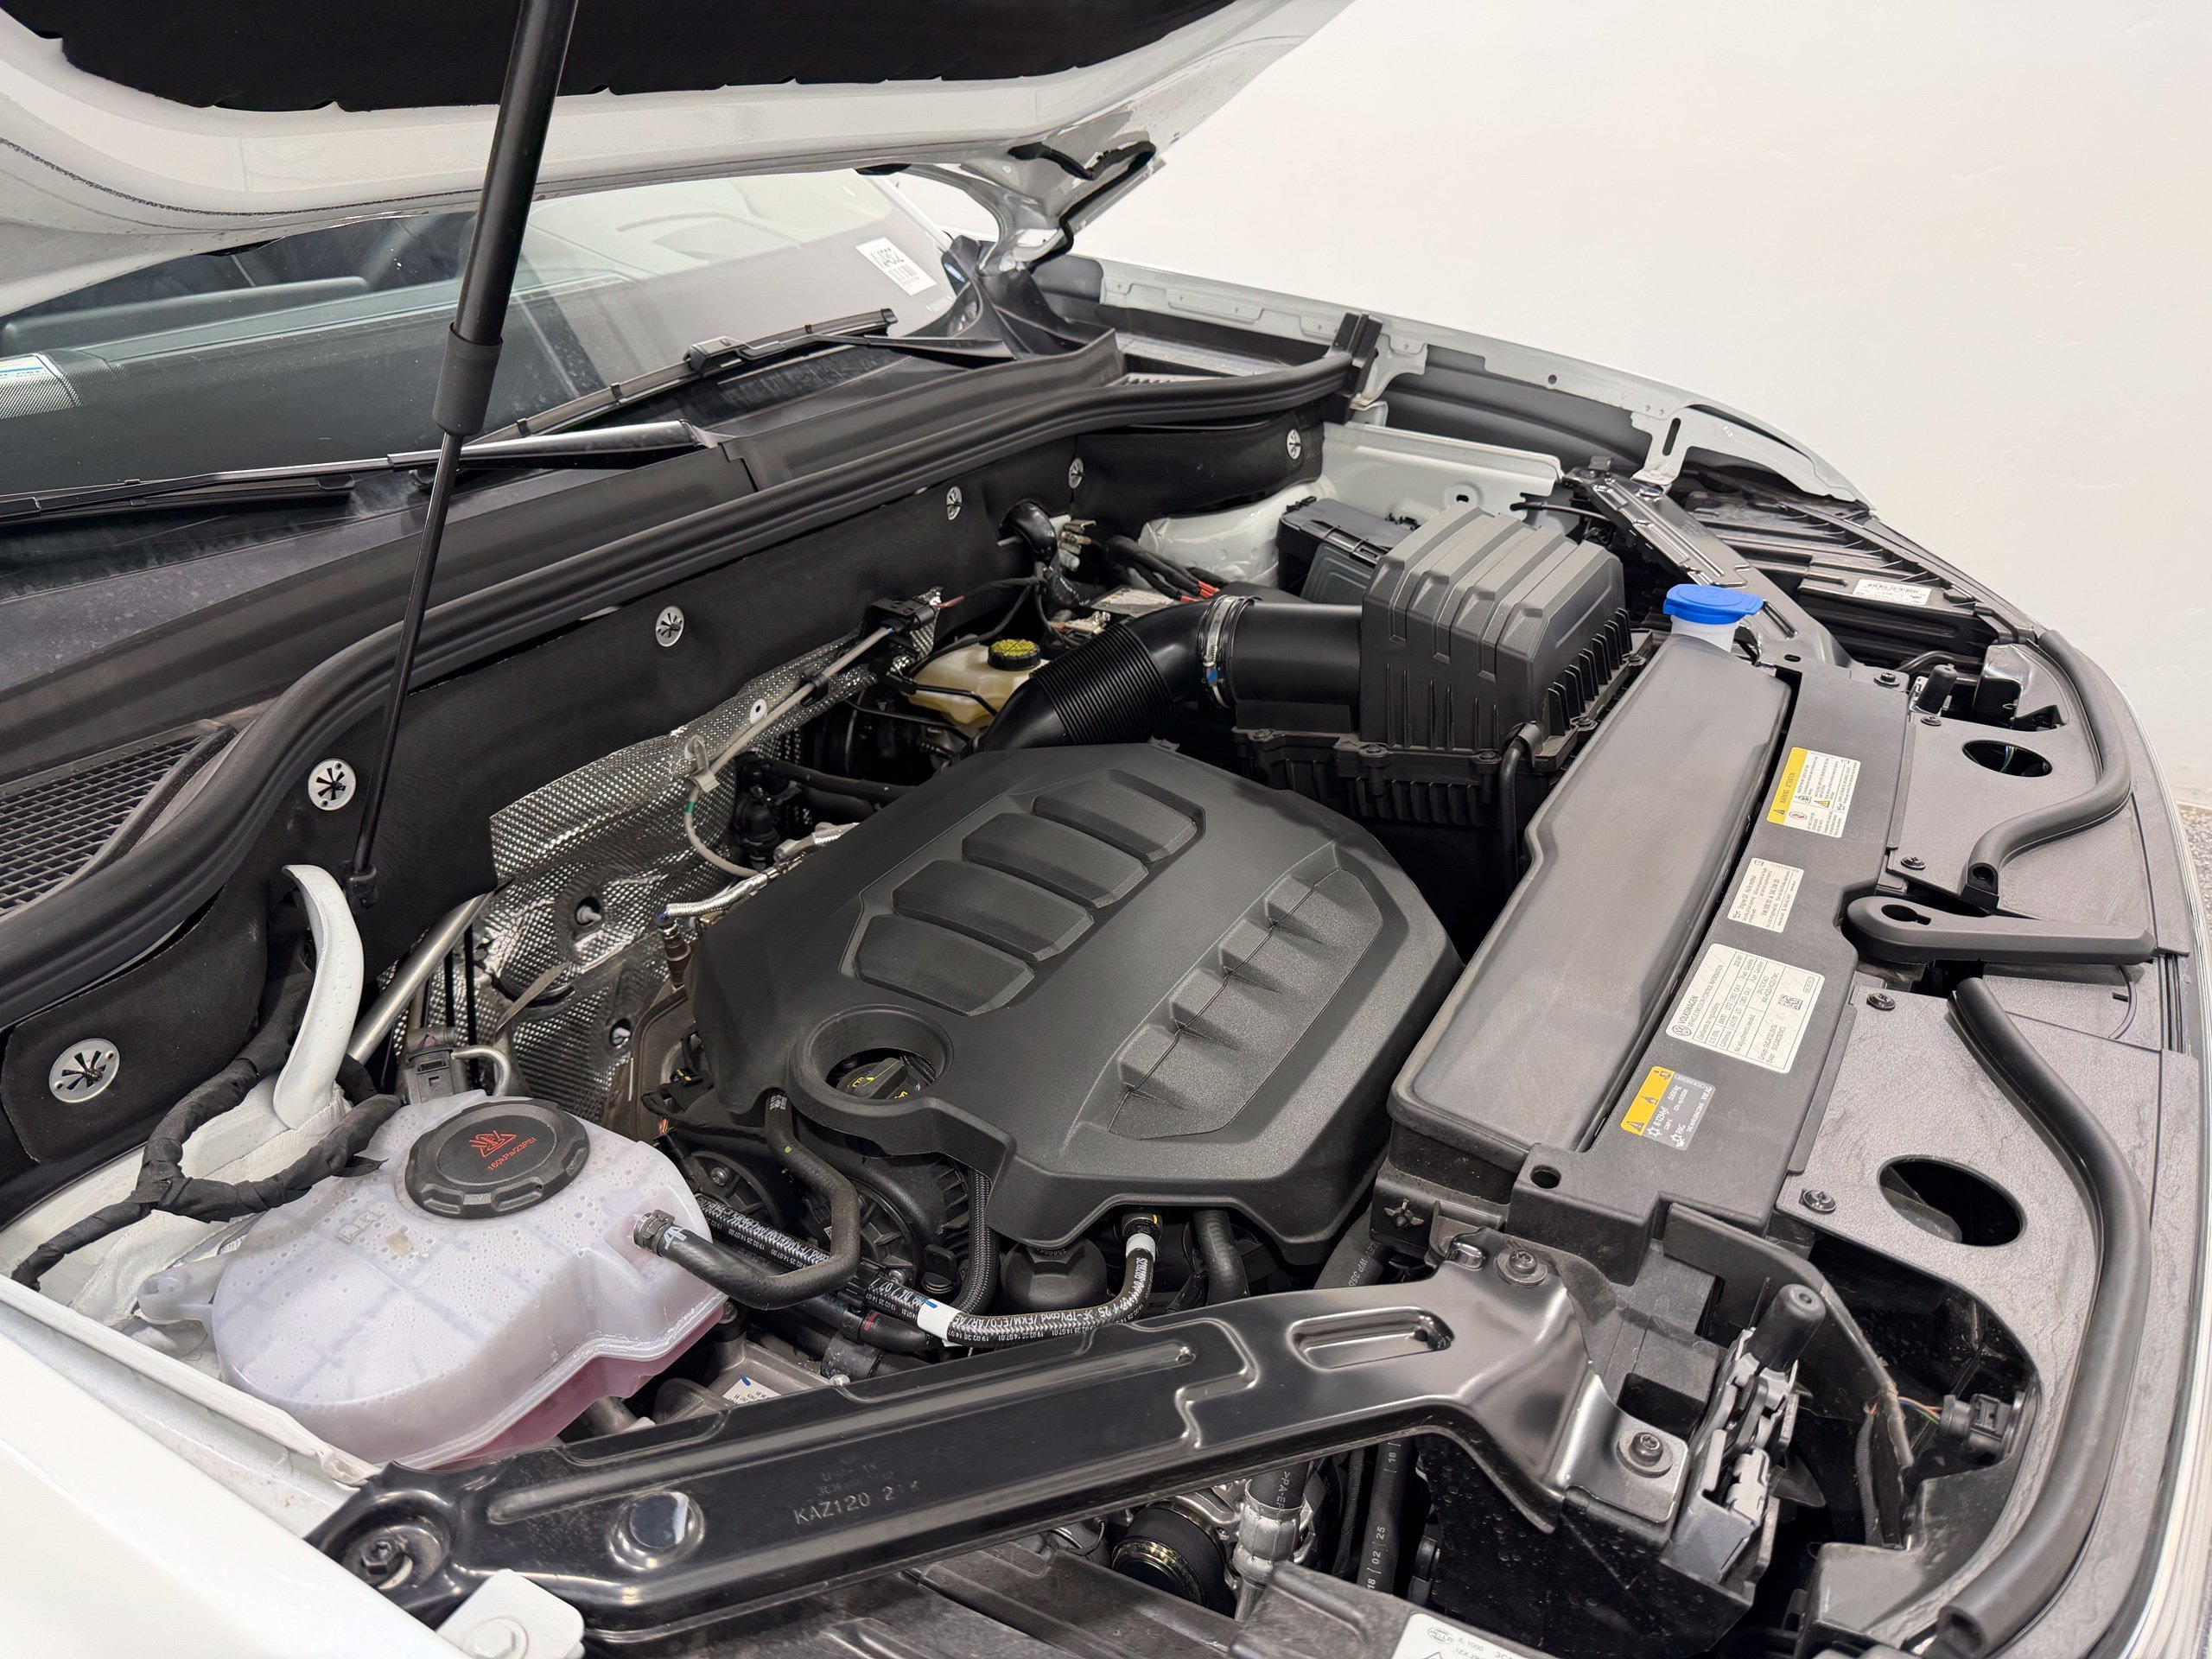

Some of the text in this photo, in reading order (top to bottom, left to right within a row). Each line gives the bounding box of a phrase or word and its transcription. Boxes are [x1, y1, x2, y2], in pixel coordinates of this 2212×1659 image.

[1676, 994, 1700, 1025] VOLKSWAGEN
[1651, 1105, 1672, 1128] R-1234yf
[1357, 1257, 1369, 1273] WP
[1388, 1452, 1396, 1463] 18
[793, 1492, 871, 1525] KAZ120
[1376, 1526, 1386, 1540] 25
[1372, 1550, 1382, 1565] 02
